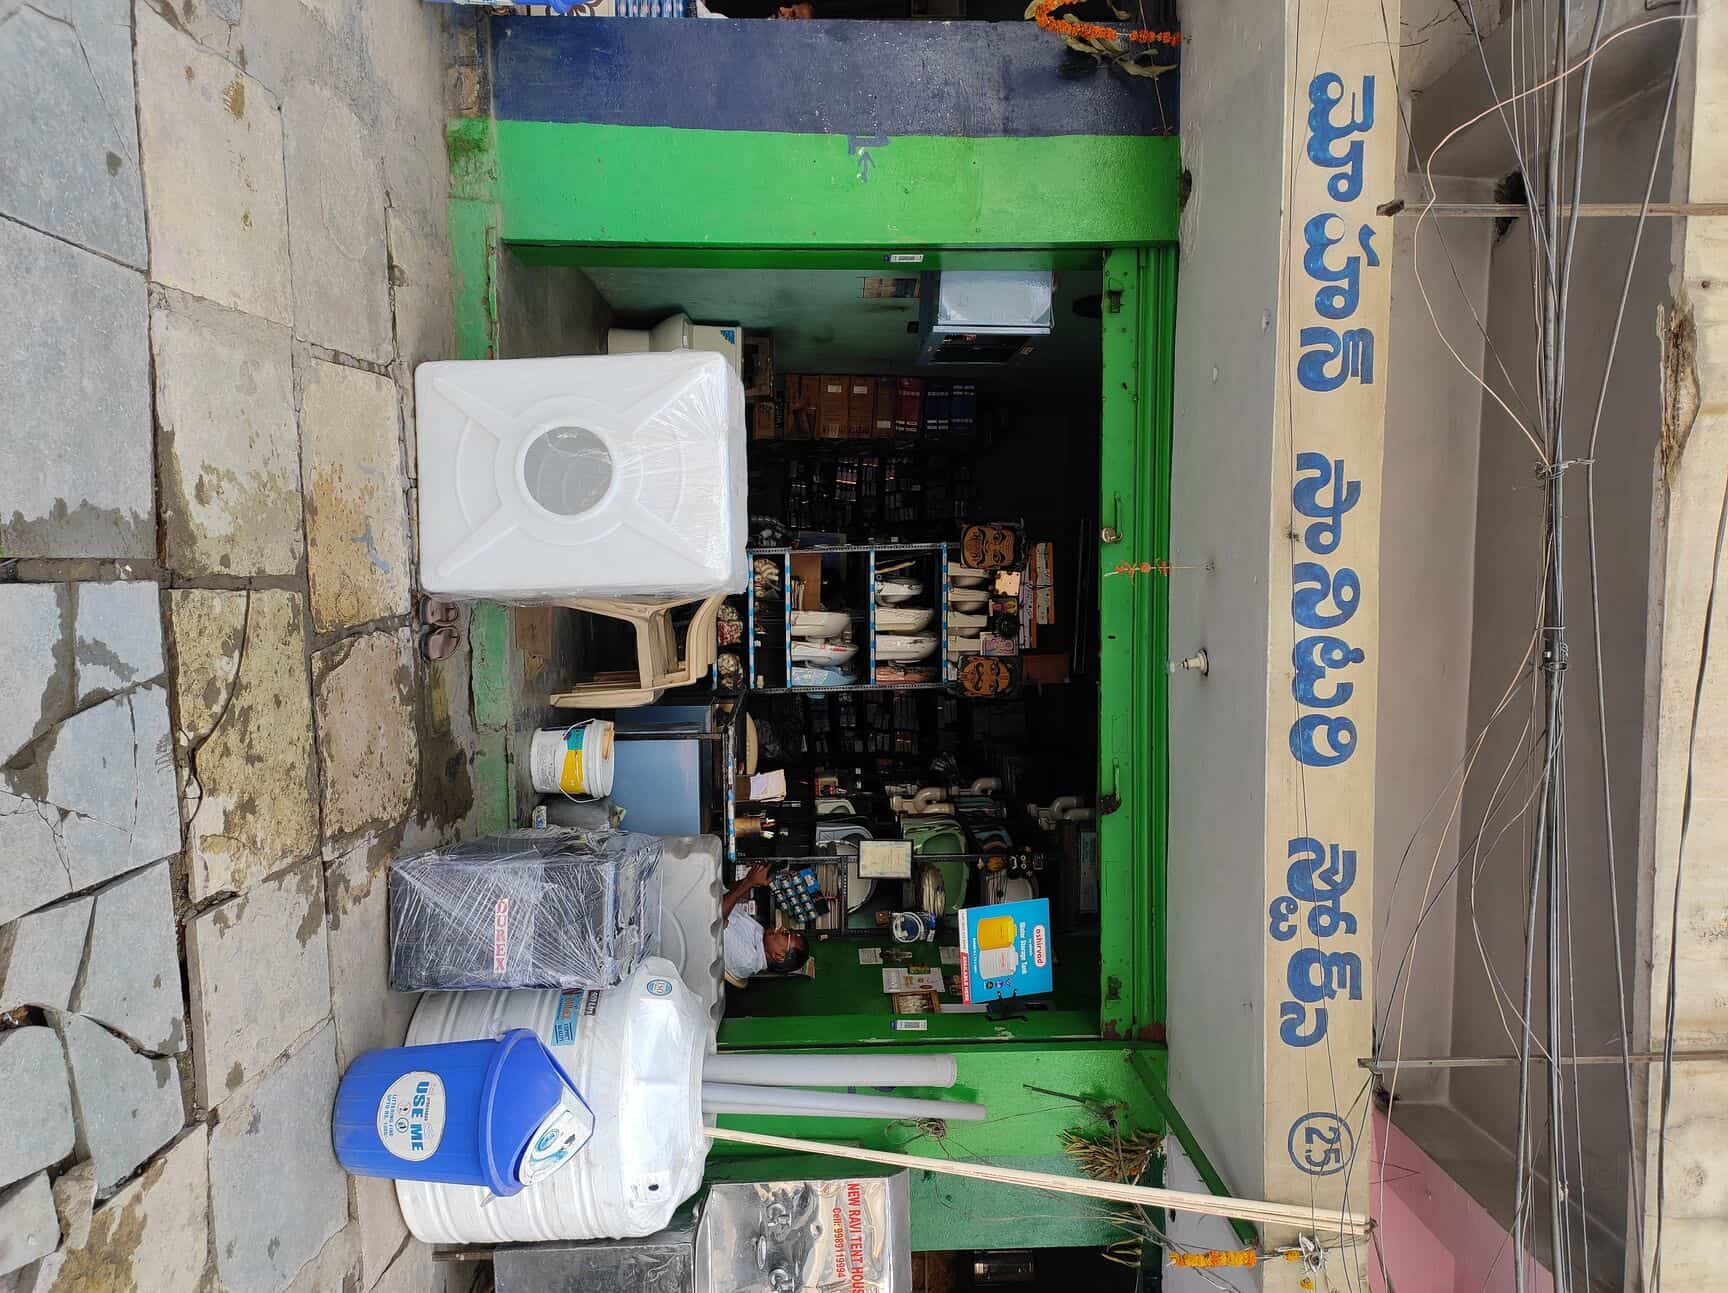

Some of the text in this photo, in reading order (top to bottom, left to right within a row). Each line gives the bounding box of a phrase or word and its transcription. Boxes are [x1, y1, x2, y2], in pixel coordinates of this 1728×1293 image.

[1296, 71, 1380, 393] మోహన్
[1289, 451, 1367, 767] సానిటరి
[410, 1081, 430, 1151] USE ME
[1304, 1125, 1342, 1168] 25
[848, 1183, 861, 1206] NEW
[848, 1209, 862, 1233] RAVI
[832, 1207, 846, 1278] Cell: 9989119994
[850, 1236, 863, 1264] TENT
